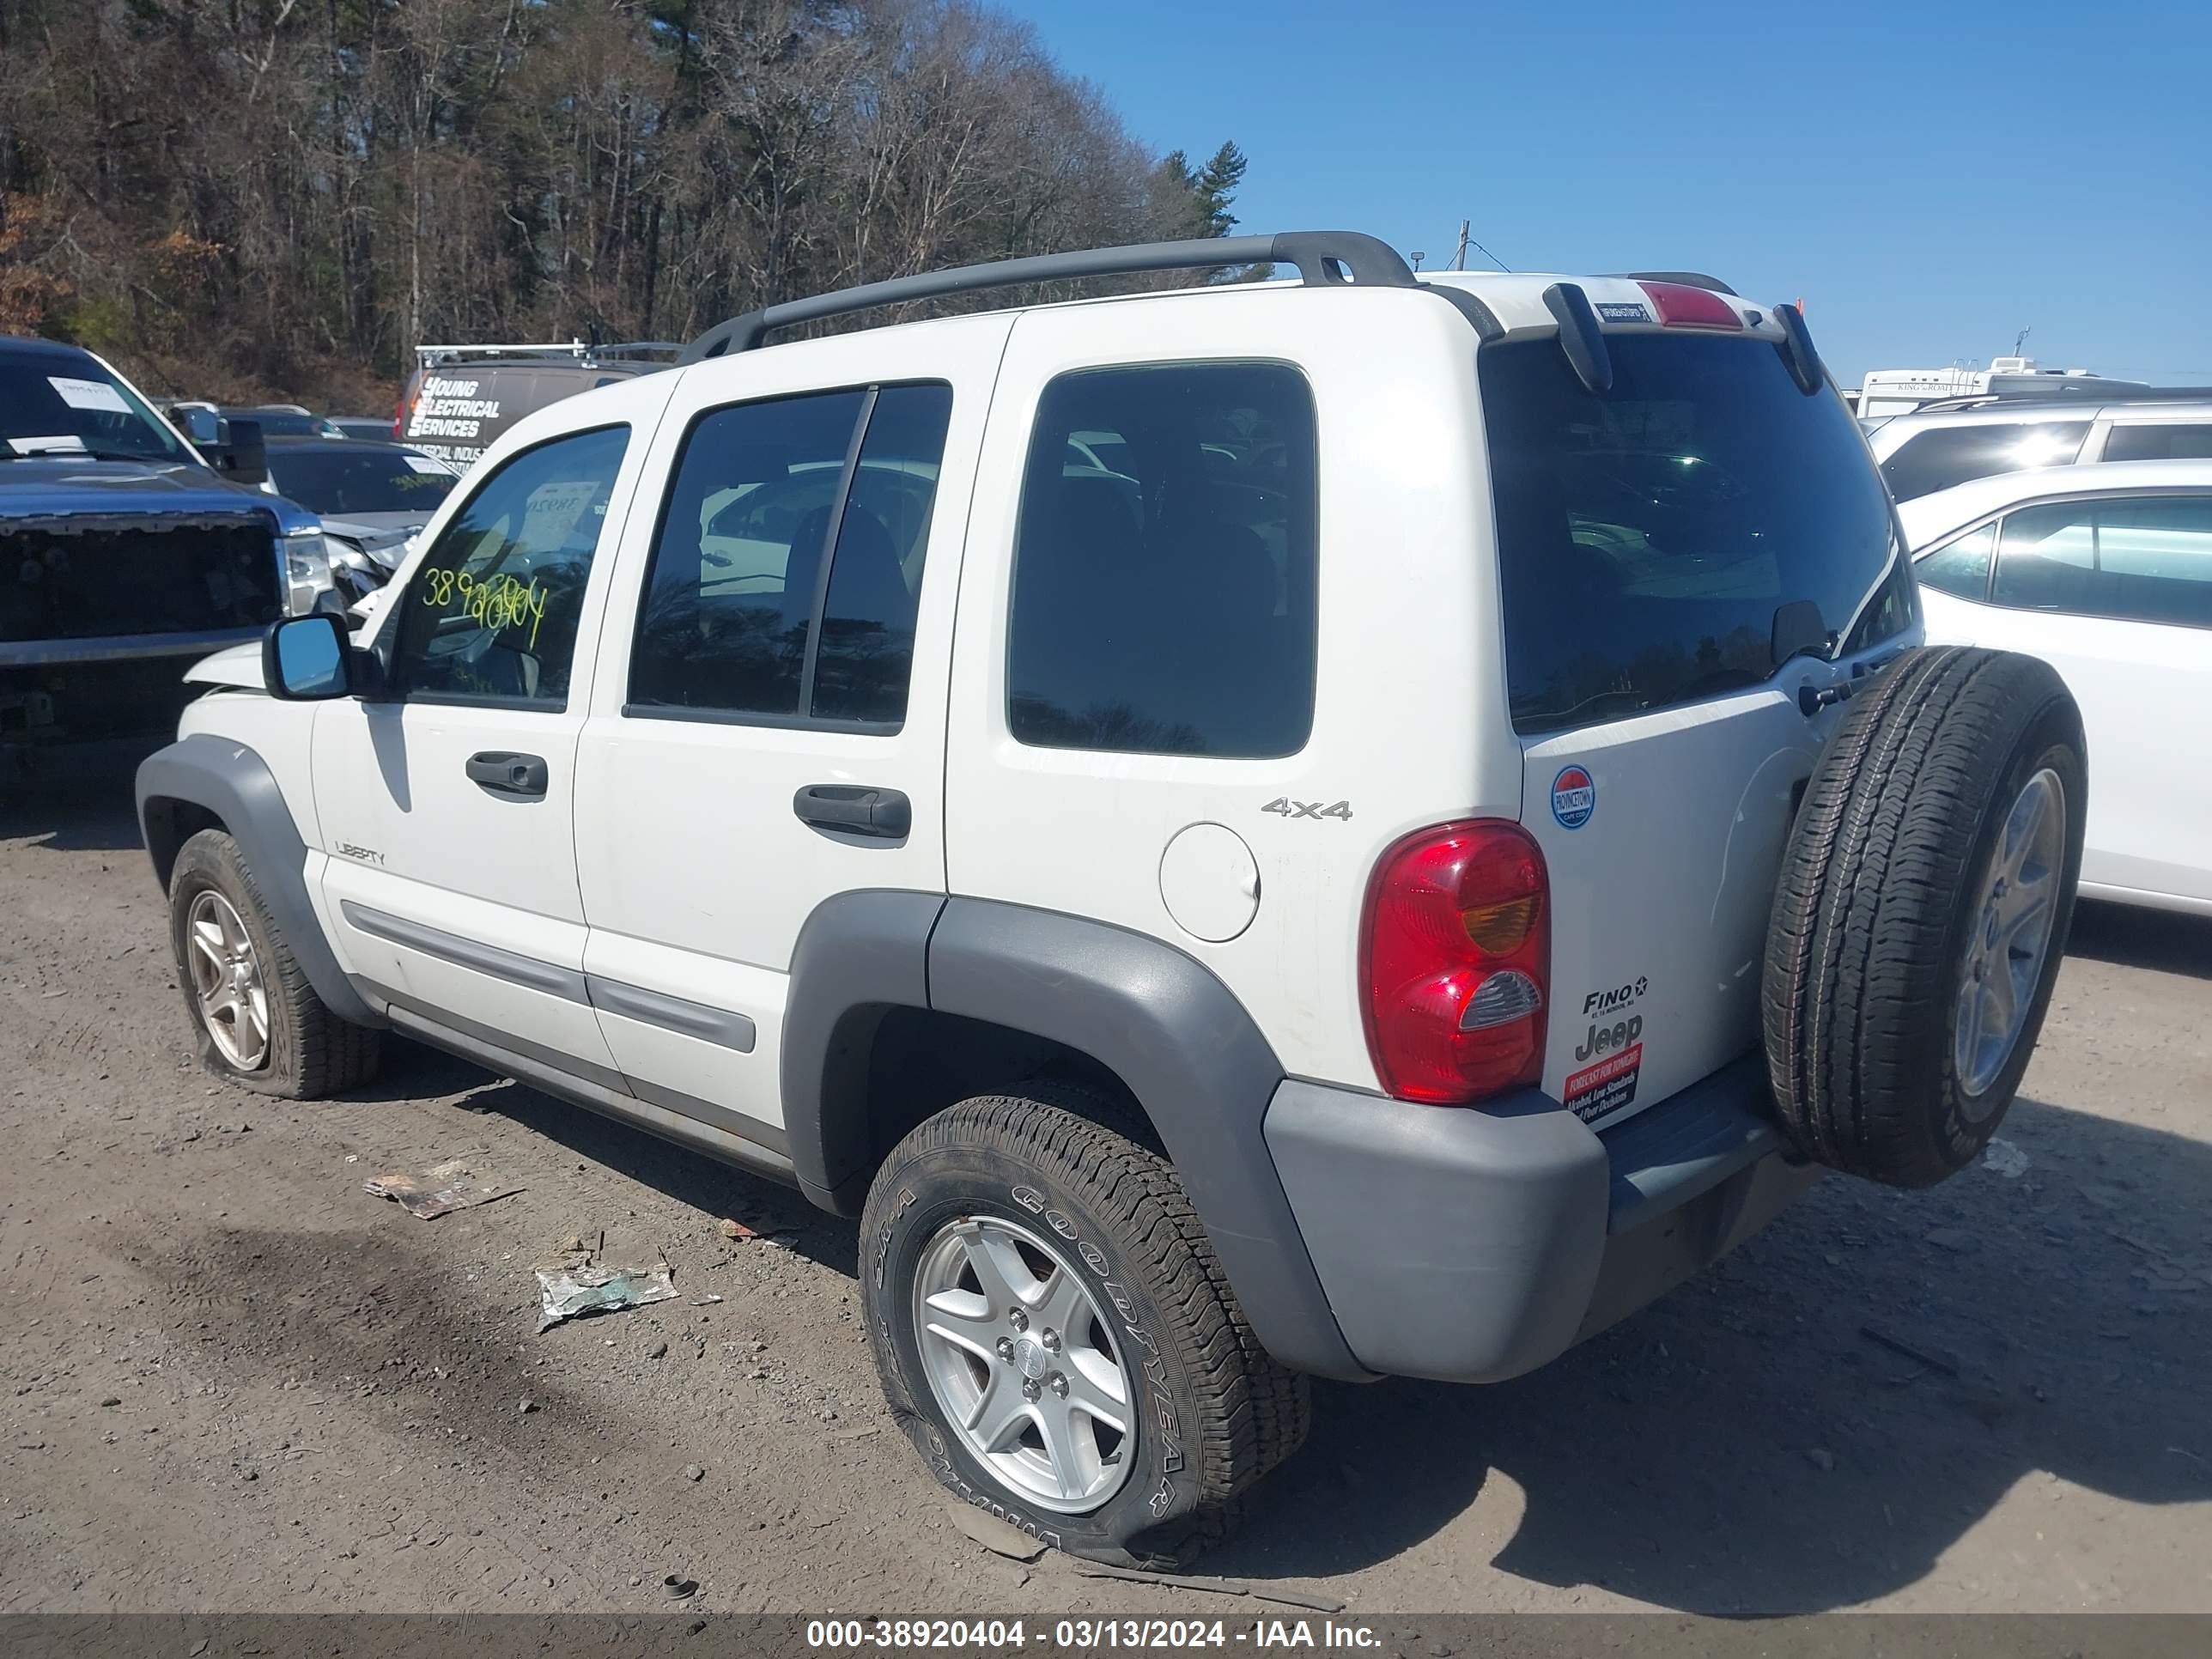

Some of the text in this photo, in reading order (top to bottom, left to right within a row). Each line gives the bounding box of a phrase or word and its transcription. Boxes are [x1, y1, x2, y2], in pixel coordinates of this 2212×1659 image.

[422, 377, 478, 398] YOUNG
[415, 398, 500, 418] ELECTRICAL
[407, 417, 480, 437] SERVICES
[1583, 985, 1632, 1014] FINO
[1575, 1014, 1643, 1062] Jeep
[1570, 1068, 1601, 1092] FORECAST
[1600, 1062, 1613, 1079] FOR
[1593, 1088, 1606, 1101] Low
[1607, 1072, 1635, 1094] Standards
[1583, 1106, 1599, 1120] Poor
[1599, 1091, 1627, 1112] Decisions
[1012, 1186, 1184, 1519] GOODYEAR
